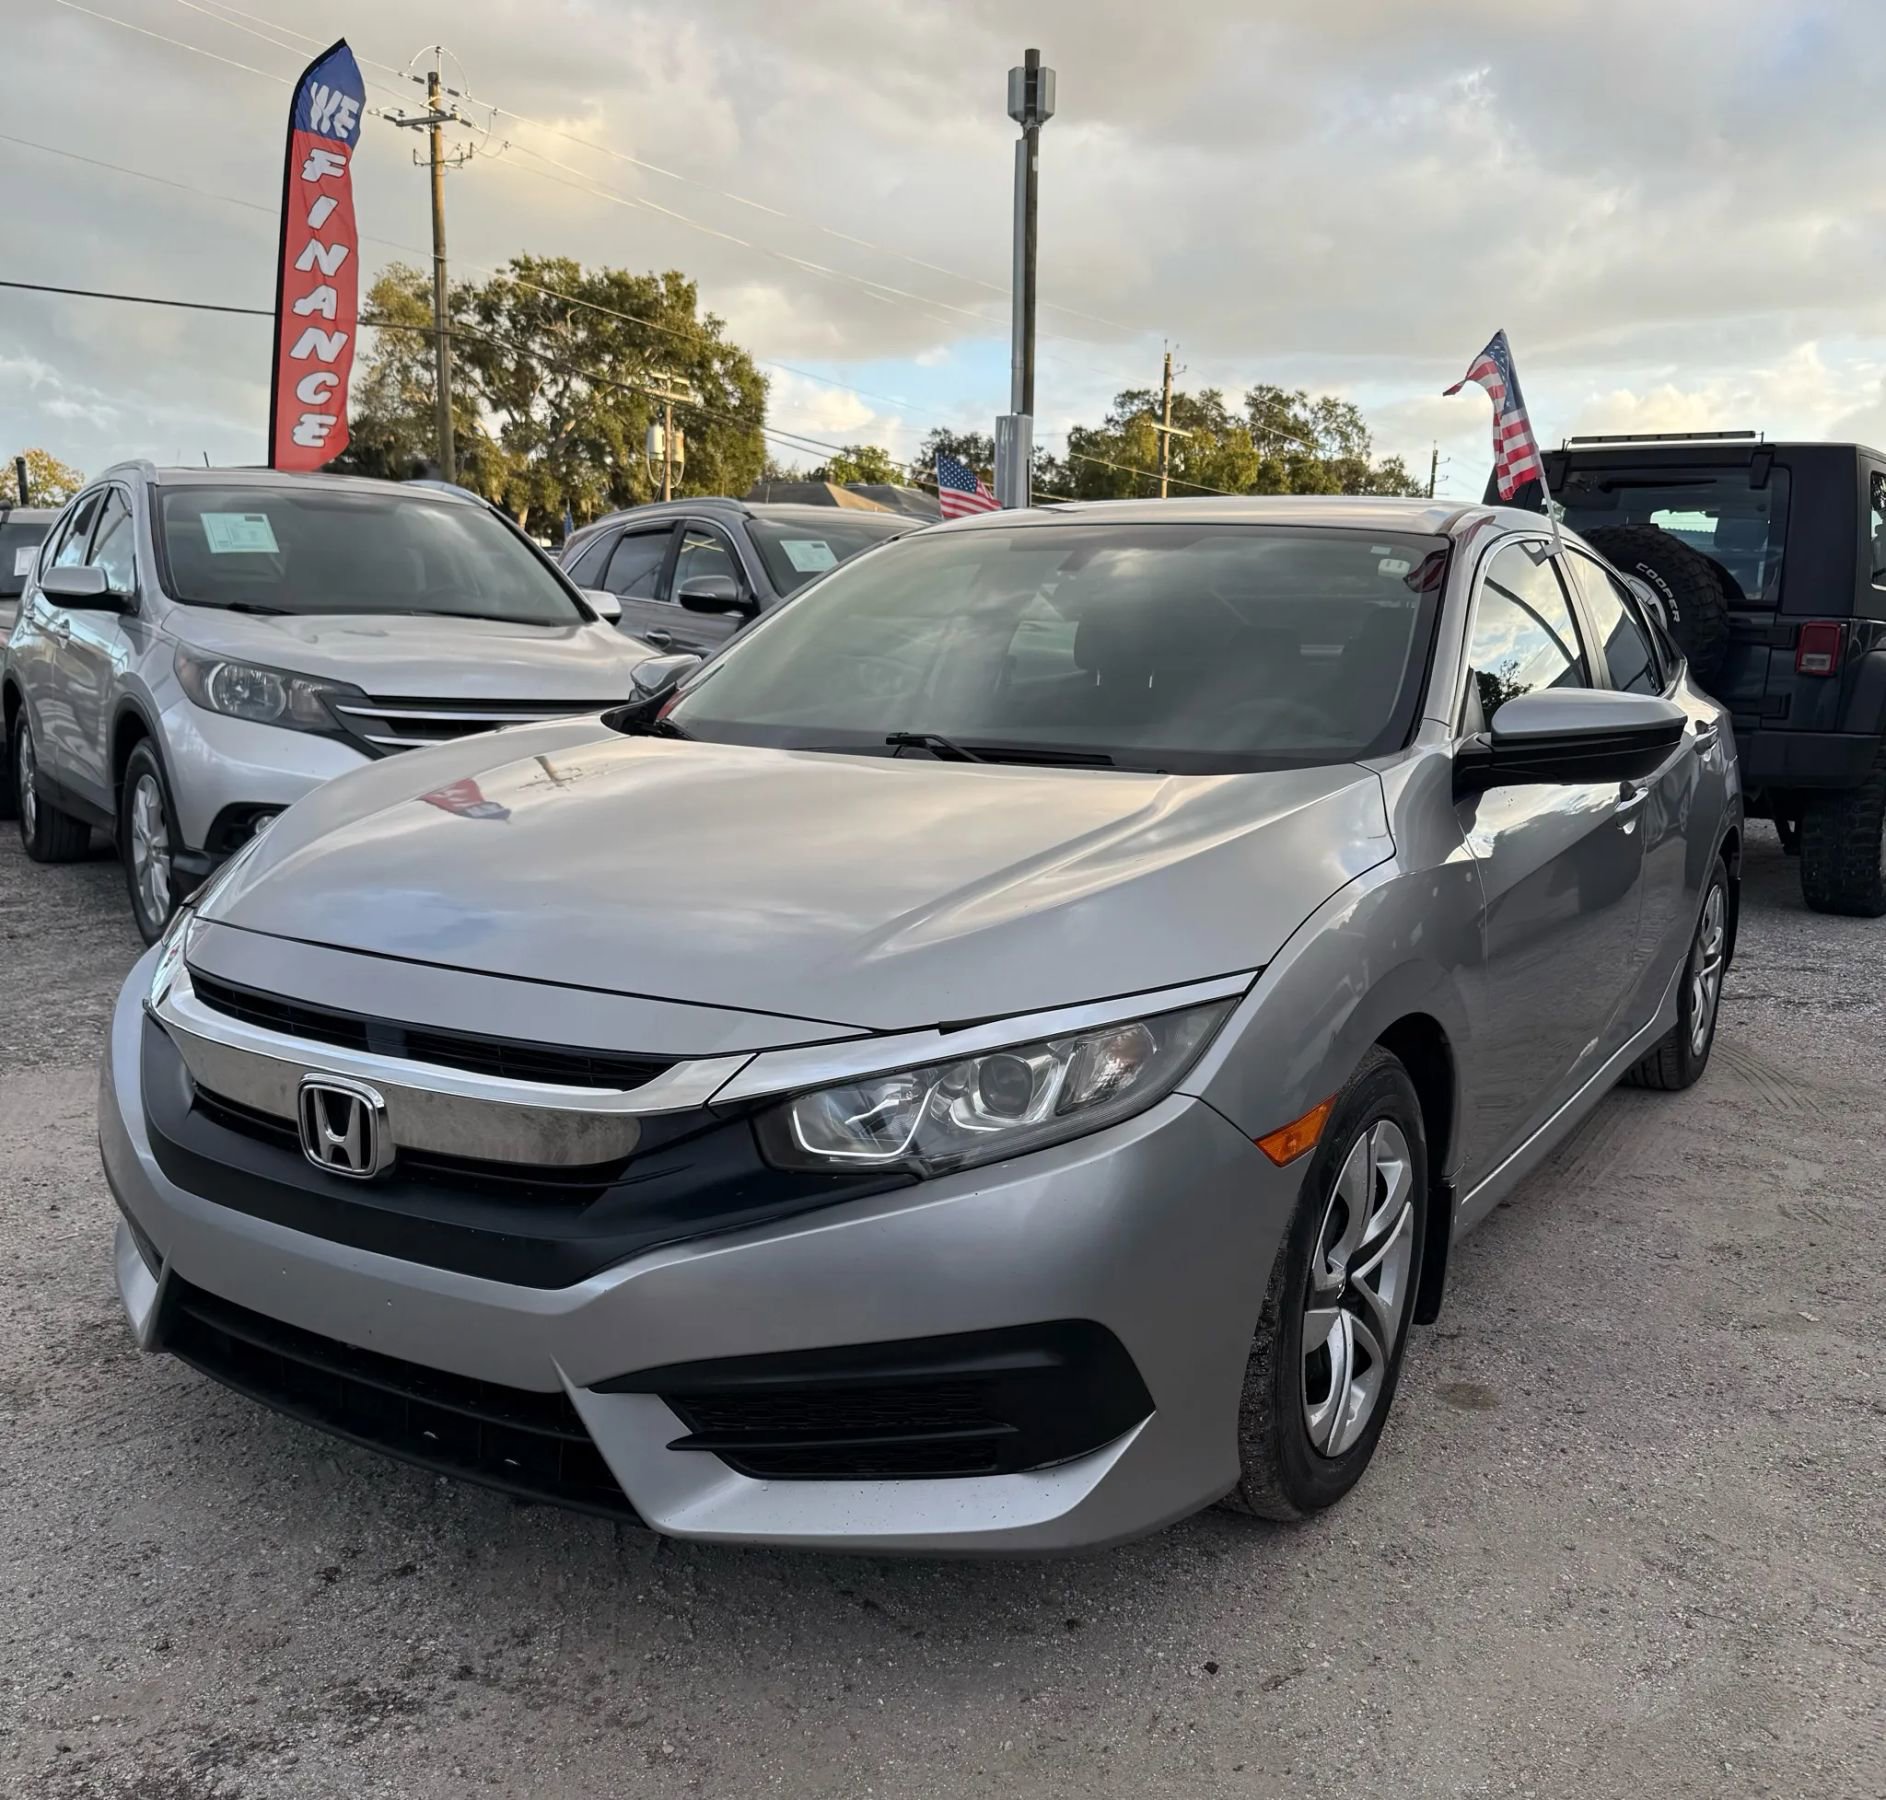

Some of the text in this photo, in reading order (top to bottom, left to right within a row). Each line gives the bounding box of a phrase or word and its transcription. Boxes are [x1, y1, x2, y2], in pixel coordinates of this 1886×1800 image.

[310, 81, 359, 138] WE
[290, 148, 349, 447] FINANCE
[1636, 562, 1680, 622] COOPER
